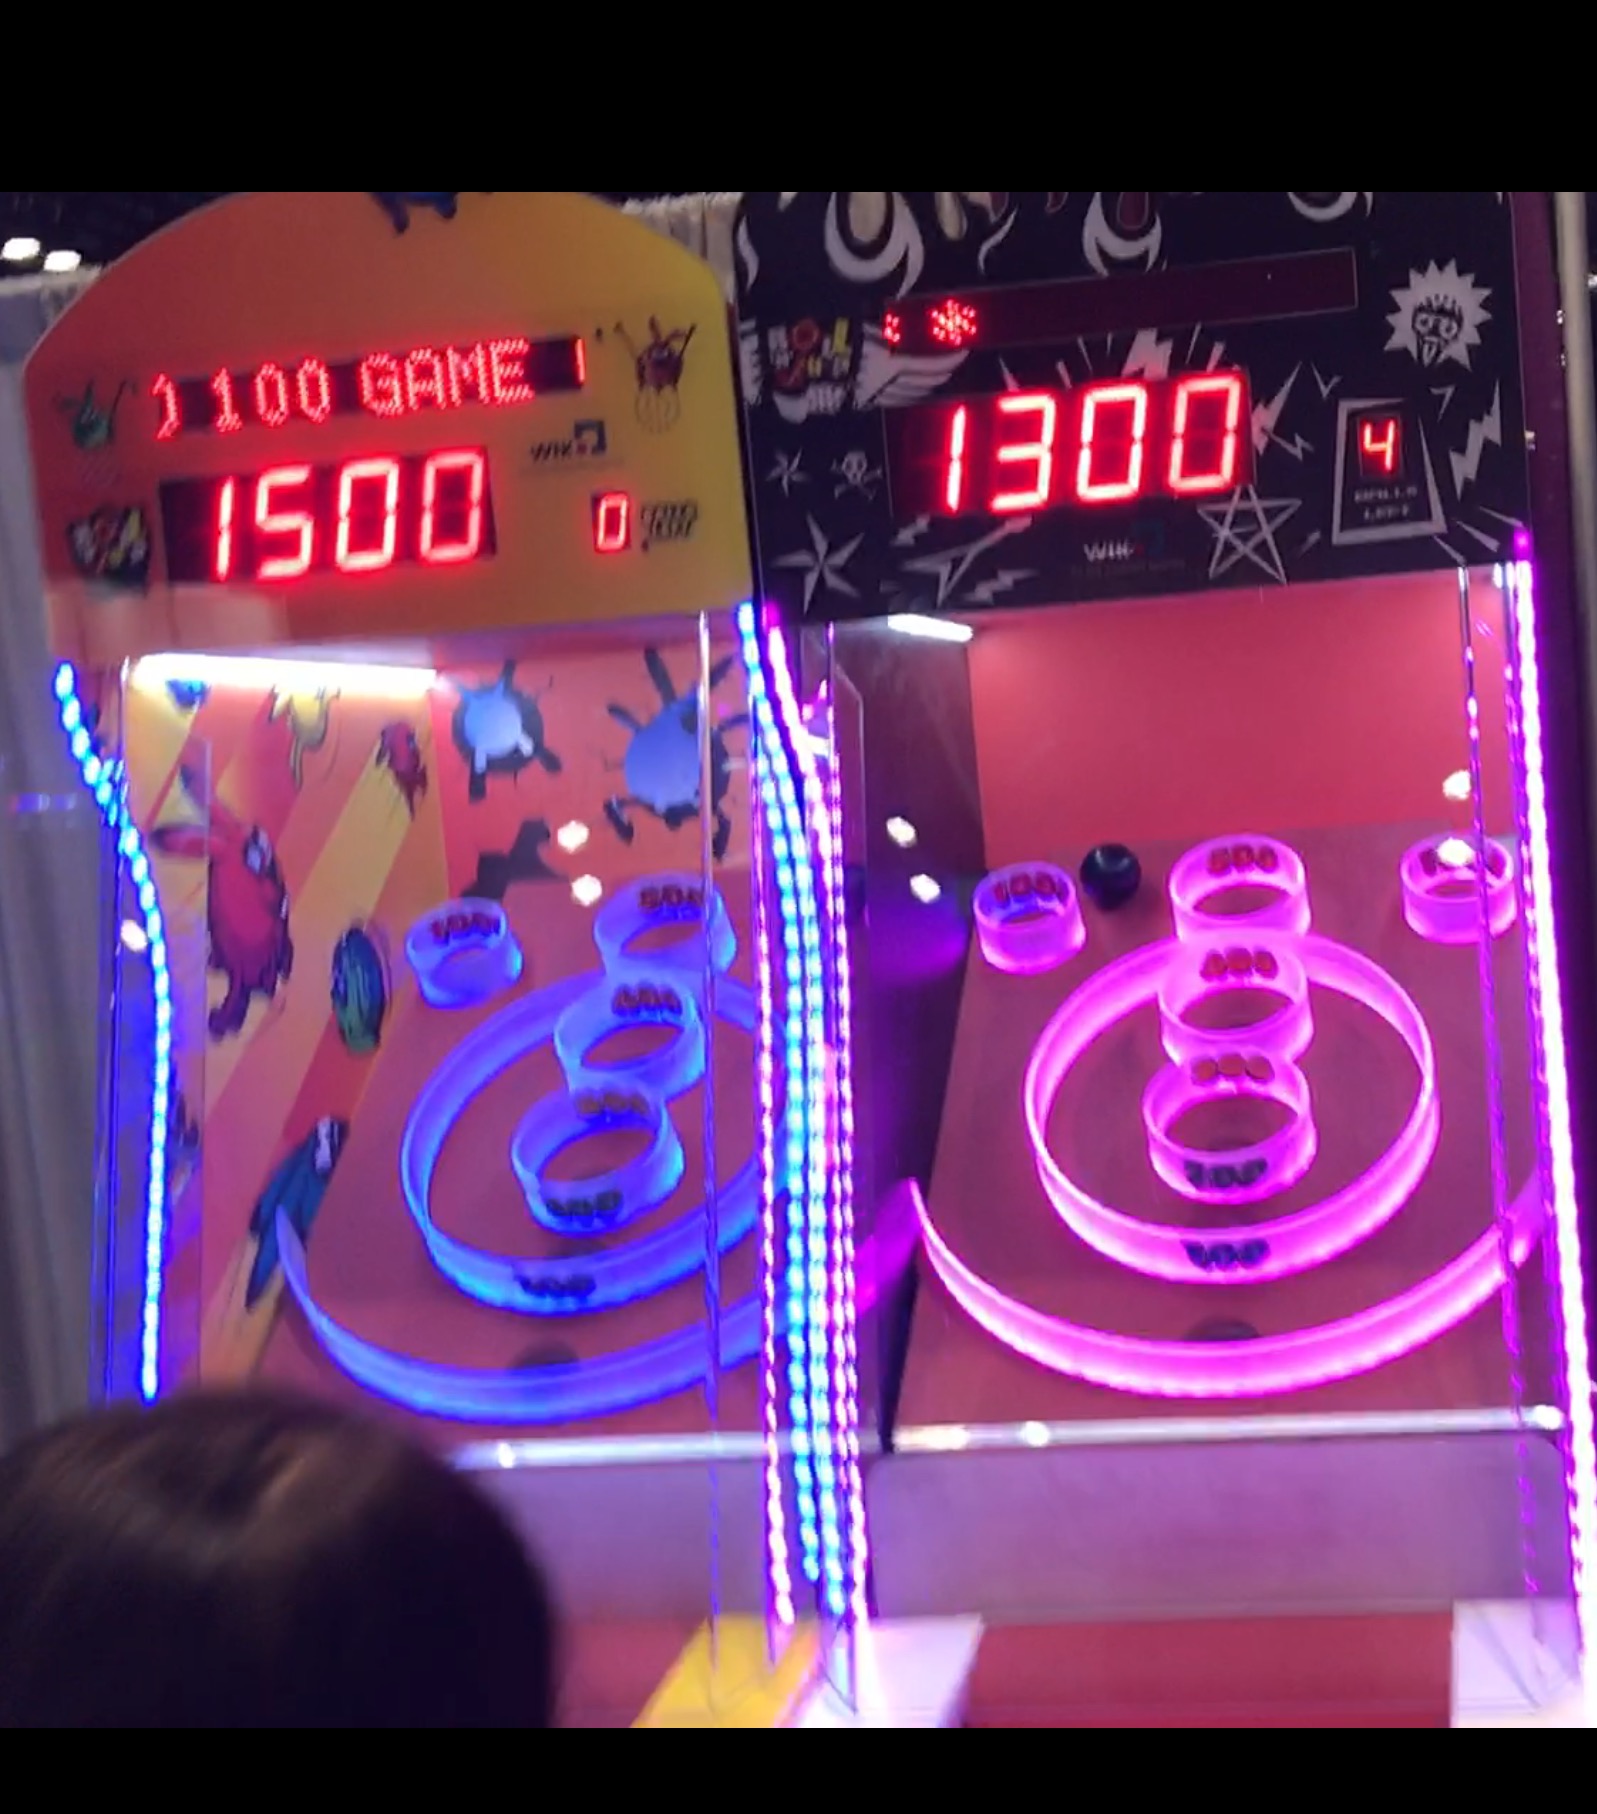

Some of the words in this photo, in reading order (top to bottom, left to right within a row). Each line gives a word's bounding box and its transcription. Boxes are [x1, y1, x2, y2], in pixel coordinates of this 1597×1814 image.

[212, 357, 331, 433] 100
[360, 337, 536, 418] GAME
[942, 372, 1243, 514] 1300
[1361, 418, 1397, 473] 4
[211, 447, 487, 582] 1500
[596, 491, 629, 552] 0
